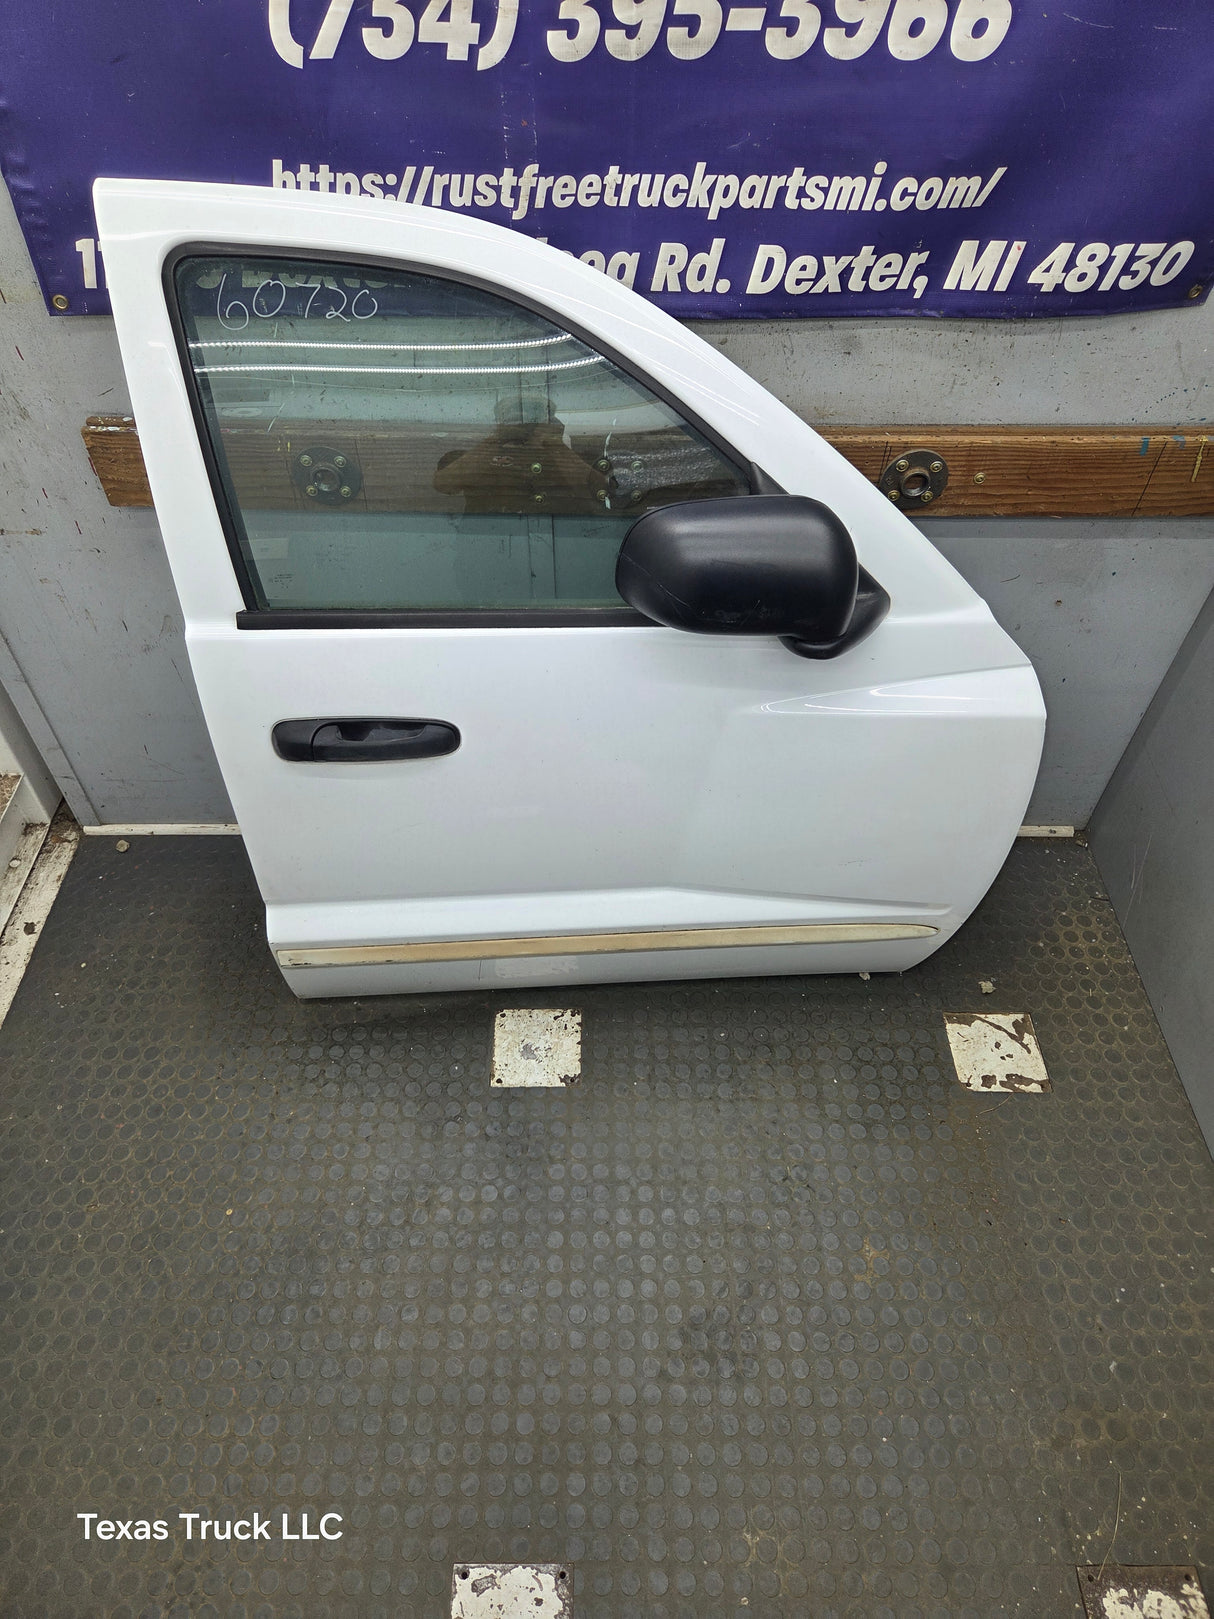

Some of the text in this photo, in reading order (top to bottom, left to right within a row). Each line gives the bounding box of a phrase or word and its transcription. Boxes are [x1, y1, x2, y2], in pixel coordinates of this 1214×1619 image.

[651, 237, 731, 294] Rd.
[745, 244, 930, 298] Dexter,
[942, 240, 1027, 292] MI
[1027, 240, 1195, 292] 48130
[216, 273, 378, 331] 60720
